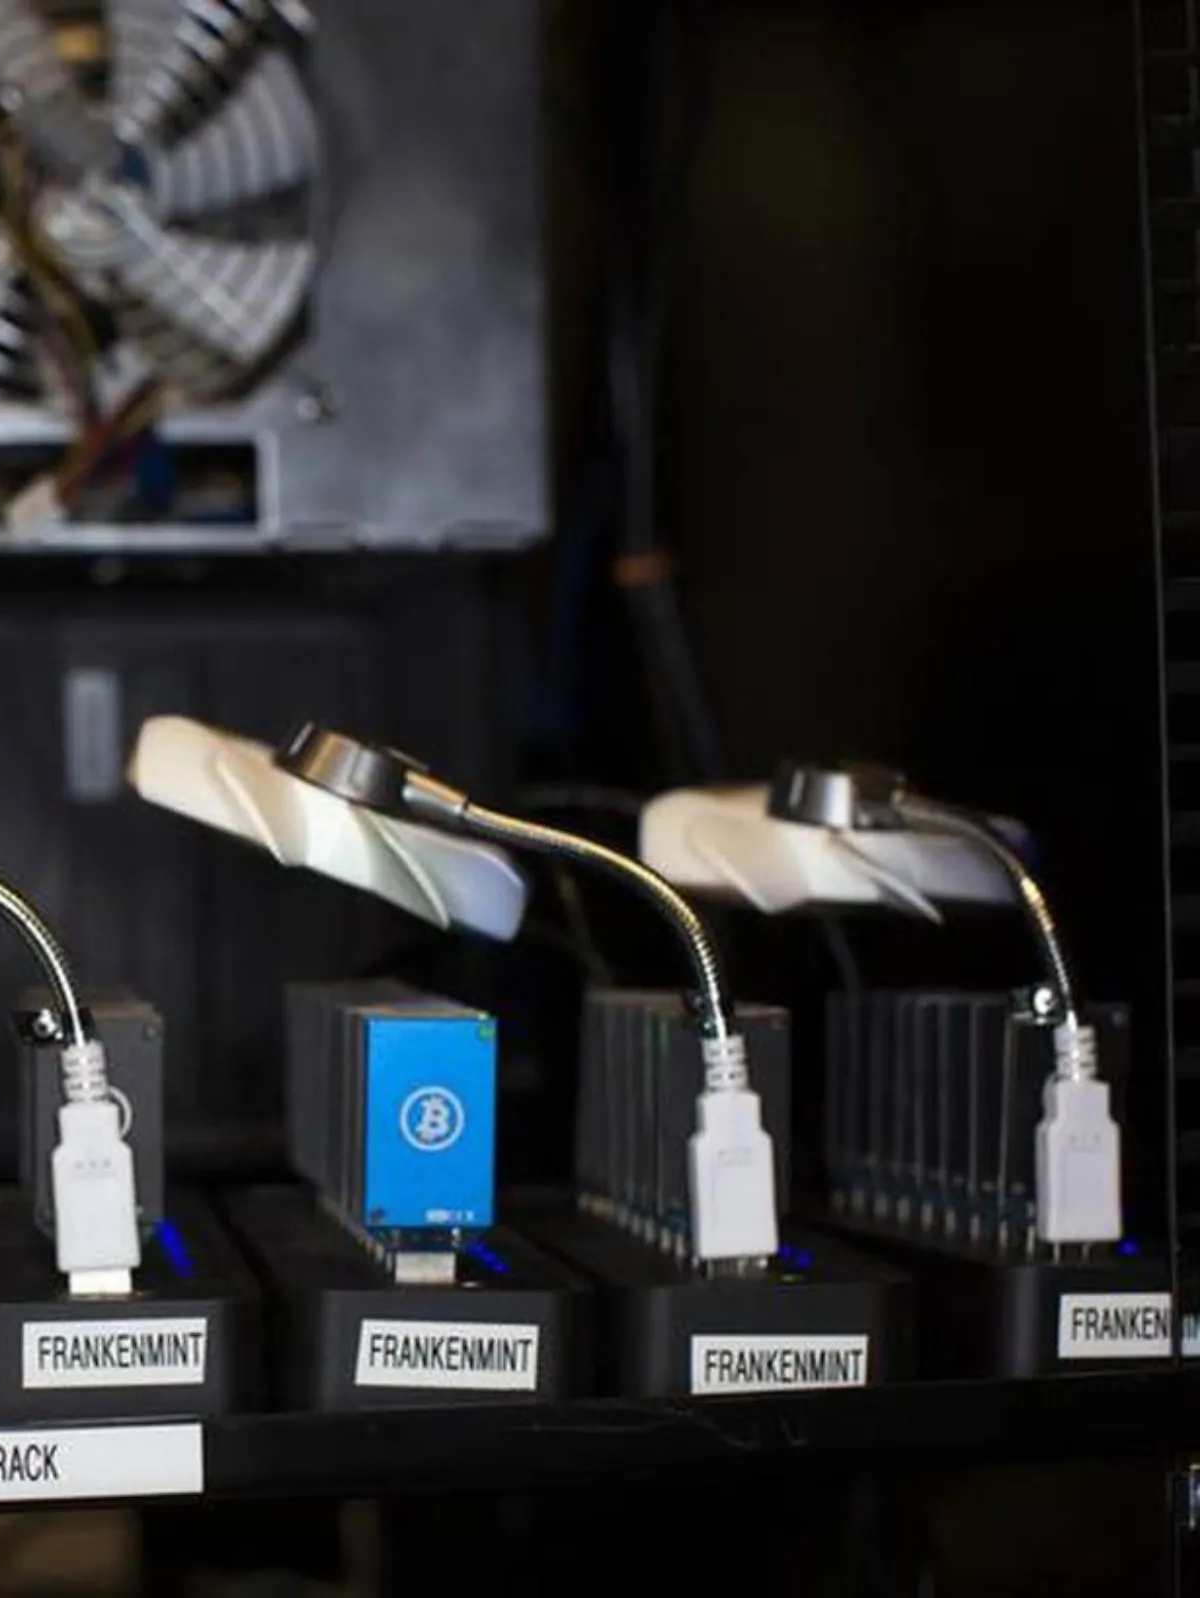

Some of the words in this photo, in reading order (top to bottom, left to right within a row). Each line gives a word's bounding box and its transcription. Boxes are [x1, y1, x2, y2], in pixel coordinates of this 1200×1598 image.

[1071, 1306, 1169, 1341] FRANKEN
[38, 1332, 203, 1370] FRANKENMINT
[369, 1334, 533, 1373] FRANKENMINT
[704, 1348, 863, 1384] FRANKENMINT
